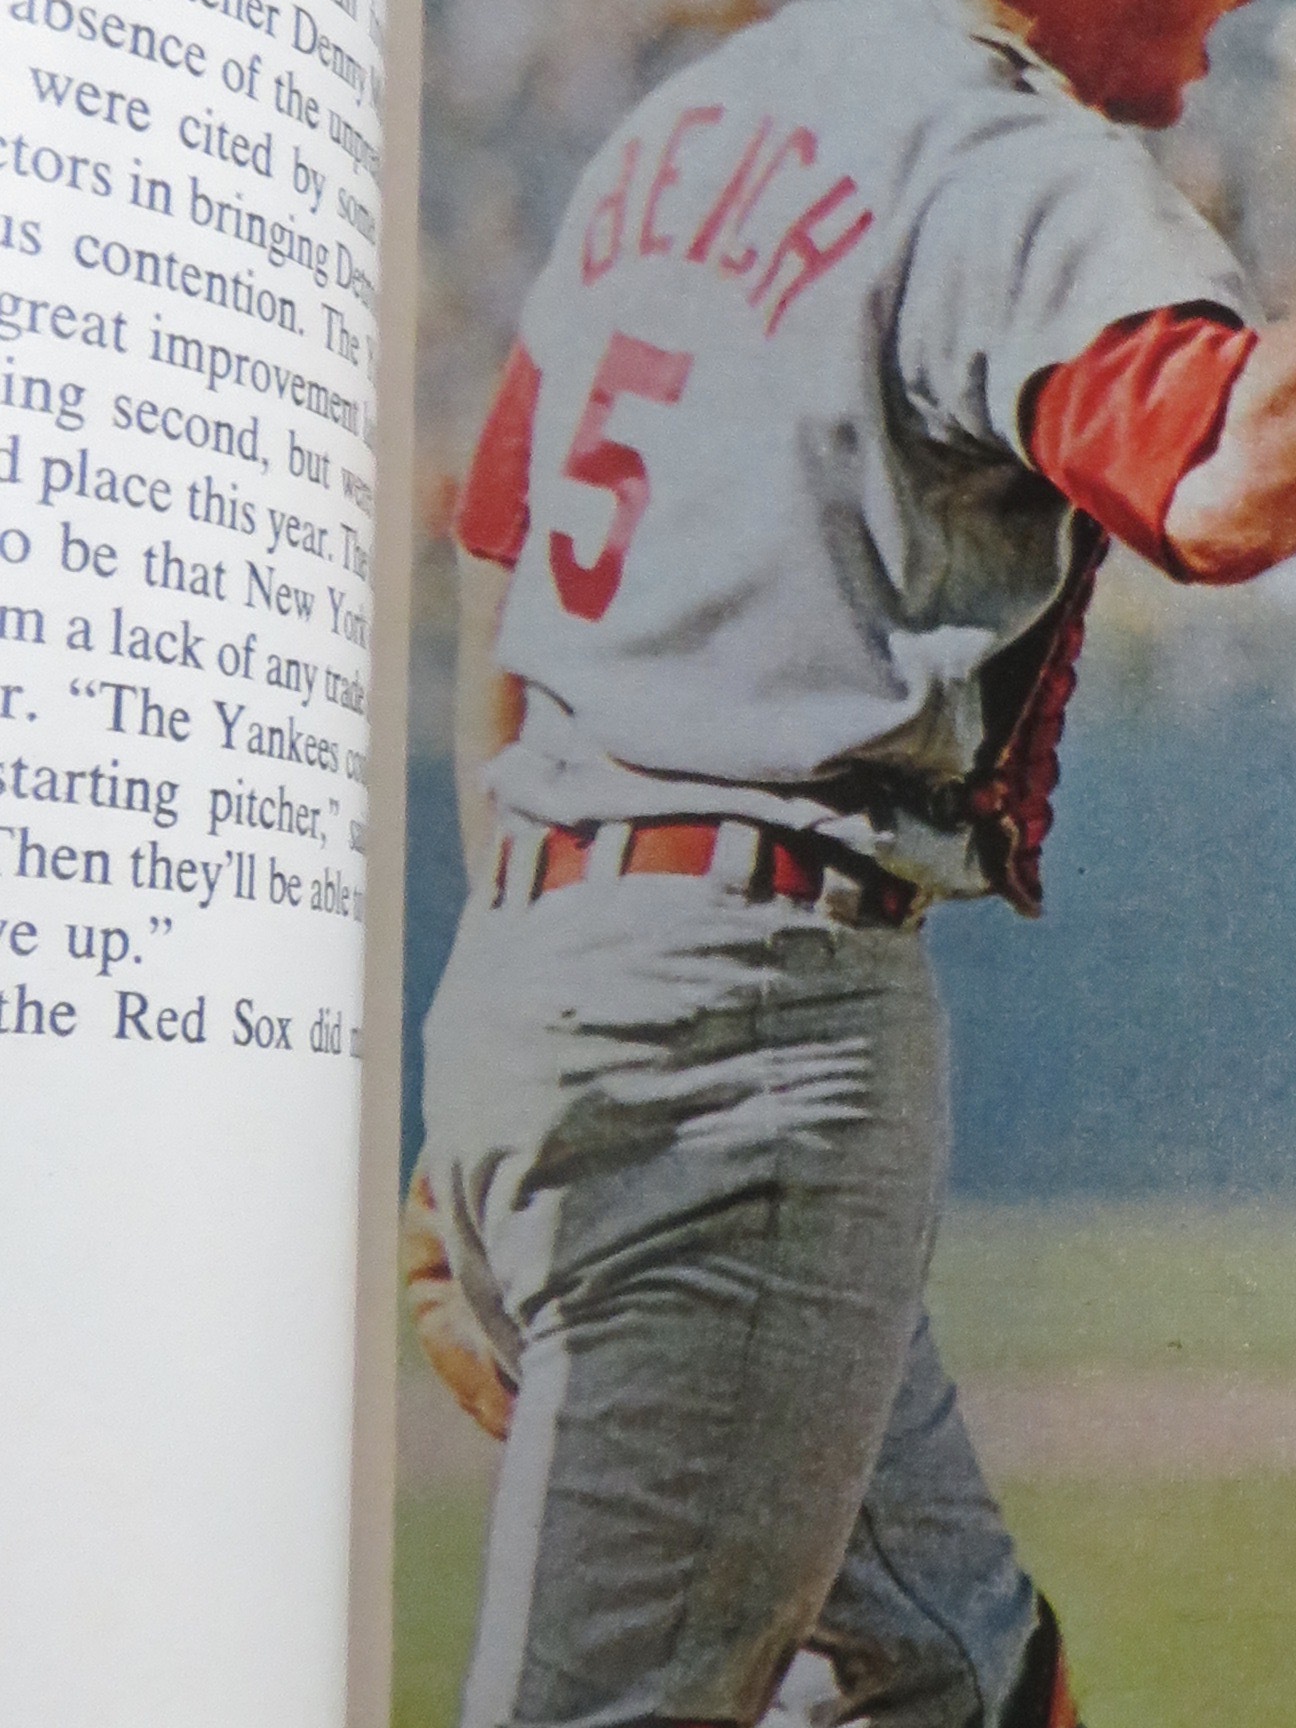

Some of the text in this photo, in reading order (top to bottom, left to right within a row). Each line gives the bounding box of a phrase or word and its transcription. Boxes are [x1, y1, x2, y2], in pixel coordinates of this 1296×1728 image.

[29, 66, 151, 132] were
[179, 108, 273, 179] cited
[293, 146, 326, 213] by
[223, 53, 263, 100] of
[275, 70, 320, 131] the
[129, 158, 174, 217] in
[190, 175, 329, 289] bringing
[74, 233, 304, 336] contention.
[321, 302, 360, 367] The
[0, 291, 127, 354] great
[149, 312, 360, 438] improvement
[0, 356, 86, 431] ing
[113, 392, 269, 474] second,
[288, 429, 331, 490] but
[37, 448, 172, 513] place
[187, 475, 256, 536] this
[267, 507, 334, 562] year.
[550, 330, 694, 622] 5
[60, 521, 118, 579] be
[143, 540, 227, 602] that
[245, 560, 315, 621] New
[66, 616, 94, 652] a
[110, 607, 205, 671] lack
[218, 633, 257, 679] of
[266, 653, 319, 707] any
[70, 678, 191, 743] "The
[213, 699, 339, 774] Yankees
[207, 779, 340, 849] pitcher,"
[0, 826, 112, 886] hen
[131, 840, 257, 909] they'll
[269, 857, 302, 907] be
[310, 866, 349, 918] able
[0, 916, 173, 977] e up."
[112, 989, 207, 1044] Red
[233, 998, 293, 1050] Sox
[310, 1007, 343, 1056] did
